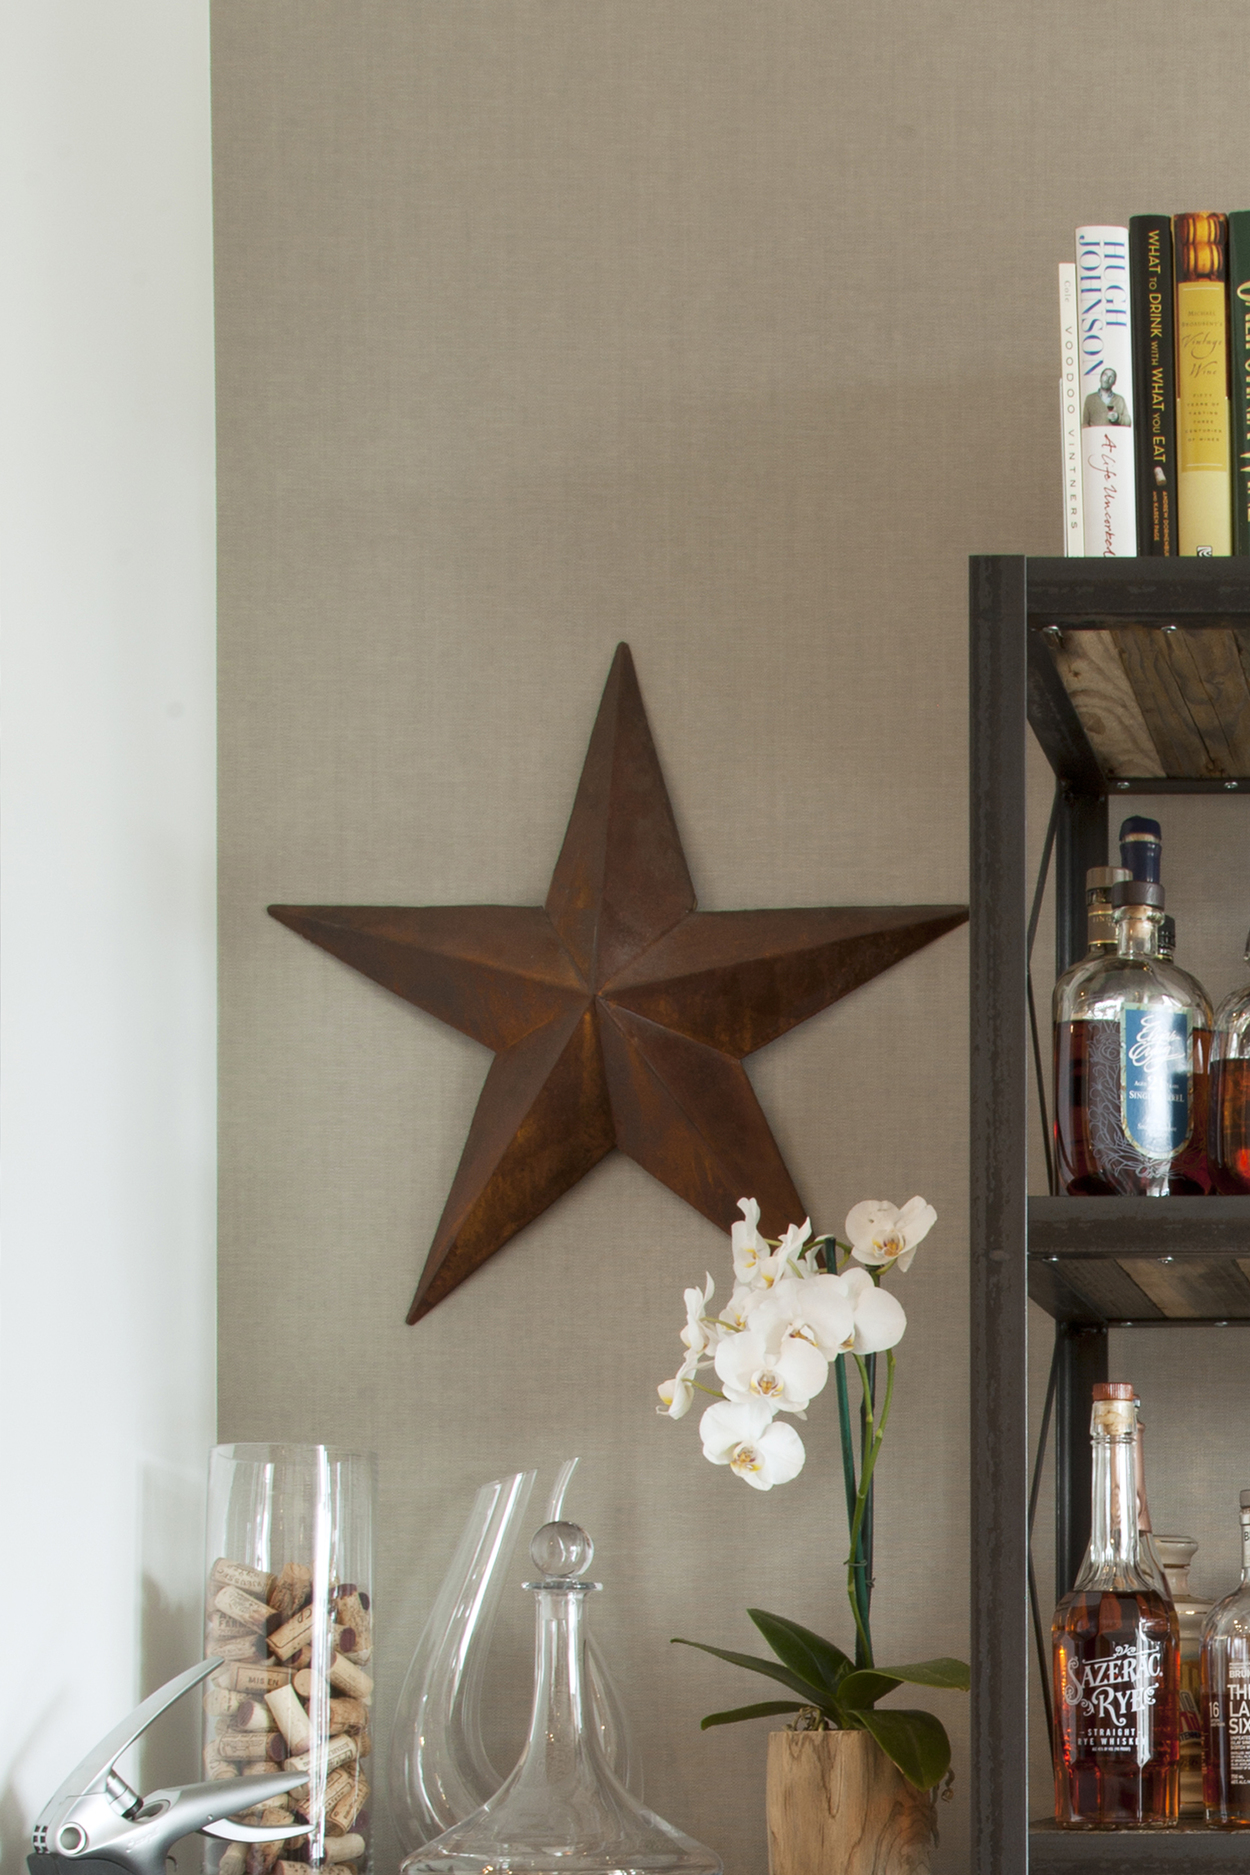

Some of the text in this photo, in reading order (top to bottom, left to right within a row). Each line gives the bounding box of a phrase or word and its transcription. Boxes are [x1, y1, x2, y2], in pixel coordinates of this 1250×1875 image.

[1079, 234, 1104, 377] JOHNSON
[1104, 240, 1127, 327] HUGH
[1149, 230, 1166, 462] WHAT TO DRINK WITH WHAT YOU EAT
[1065, 327, 1079, 529] VOODOO VINTNERS
[248, 1675, 279, 1687] MIS EN
[1091, 1683, 1159, 1727] RYE
[1209, 1701, 1221, 1719] 16
[1077, 1737, 1096, 1746] RYE
[1087, 1728, 1136, 1737] STRAIGHT
